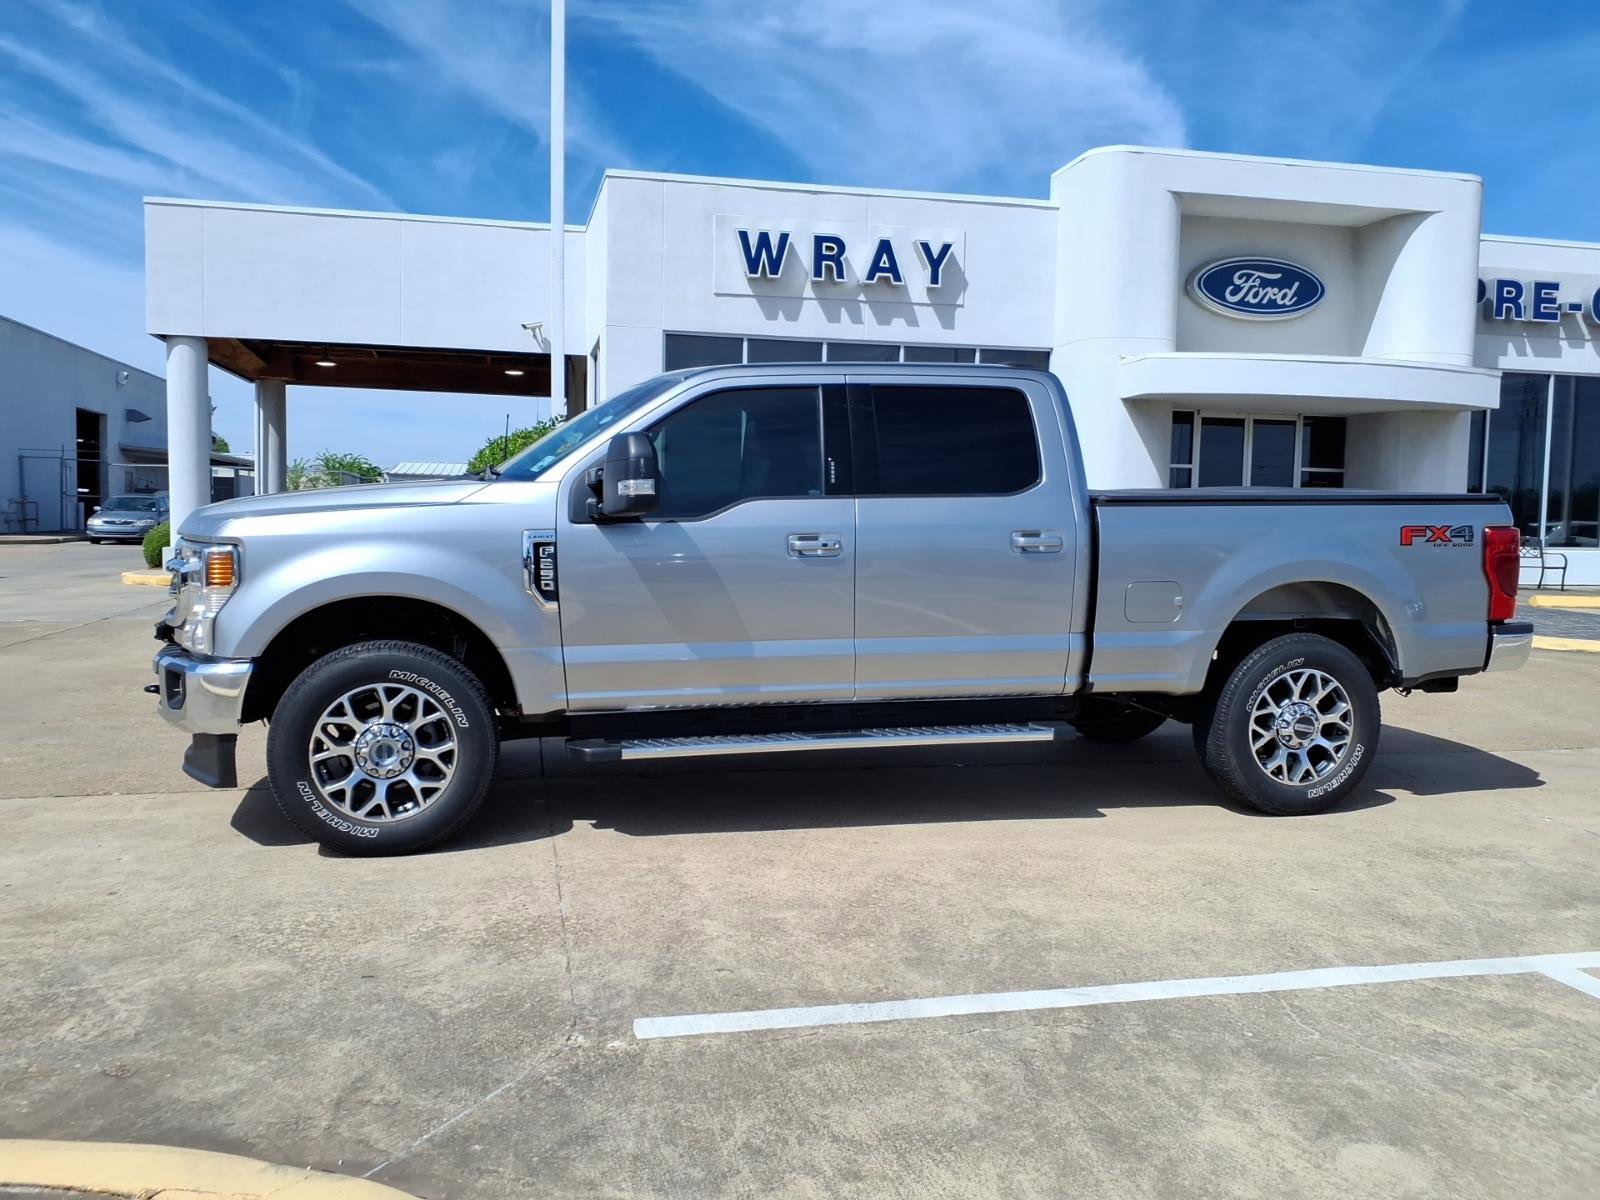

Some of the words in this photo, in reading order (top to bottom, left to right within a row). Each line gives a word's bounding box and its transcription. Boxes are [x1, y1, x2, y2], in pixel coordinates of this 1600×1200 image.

[736, 228, 956, 288] WRAY
[1225, 269, 1300, 305] Ford
[1477, 278, 1600, 324] RE-
[1400, 525, 1474, 546] FX4
[389, 669, 469, 728] MICHELIN
[1308, 743, 1364, 799] MICHELIN
[296, 781, 380, 838] MICHELIN
